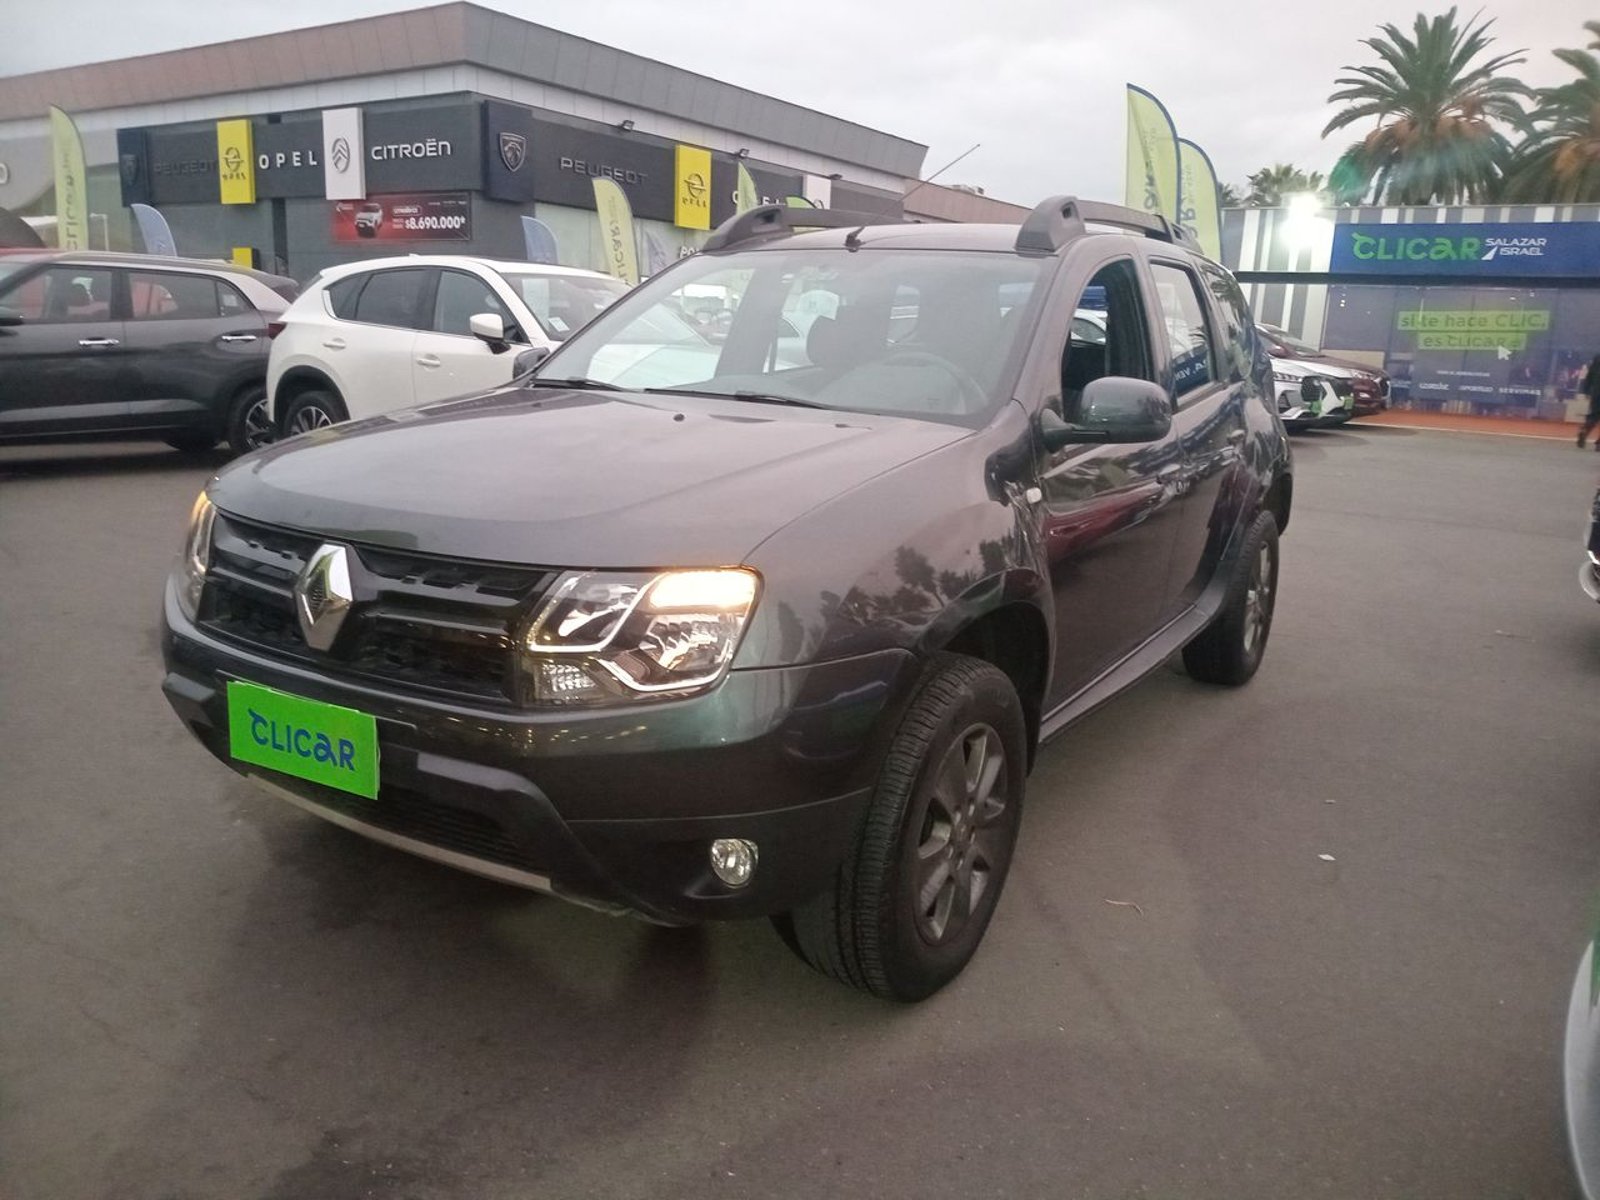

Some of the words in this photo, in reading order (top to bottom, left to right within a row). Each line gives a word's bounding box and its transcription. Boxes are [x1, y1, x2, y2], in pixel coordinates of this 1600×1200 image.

[371, 138, 451, 160] CITROËN
[258, 151, 318, 169] OPEL
[560, 156, 649, 185] PEUGEOT
[1485, 237, 1547, 248] SALAZAR
[1499, 246, 1545, 257] ISRAEL
[1444, 314, 1489, 328] hace
[248, 708, 356, 772] CLICAR
